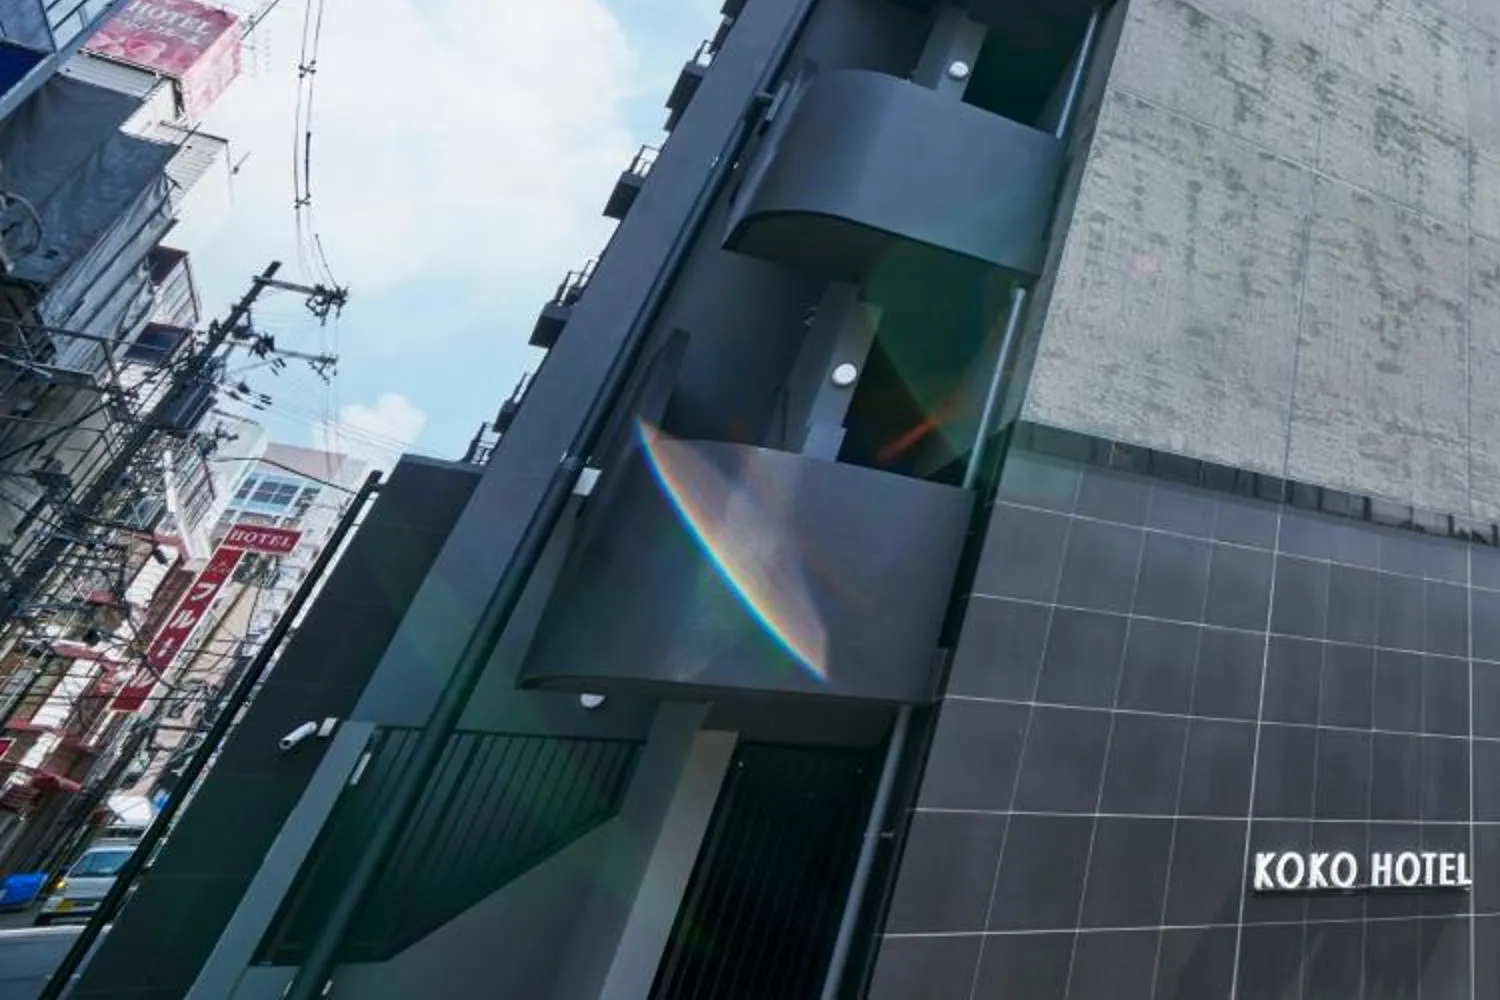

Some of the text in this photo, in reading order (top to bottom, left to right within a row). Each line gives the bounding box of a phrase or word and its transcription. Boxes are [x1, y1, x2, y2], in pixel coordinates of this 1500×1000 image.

[127, 0, 213, 35] HOTEL
[230, 529, 292, 549] HOTEL
[1254, 851, 1473, 890] KOKO HOTEL
